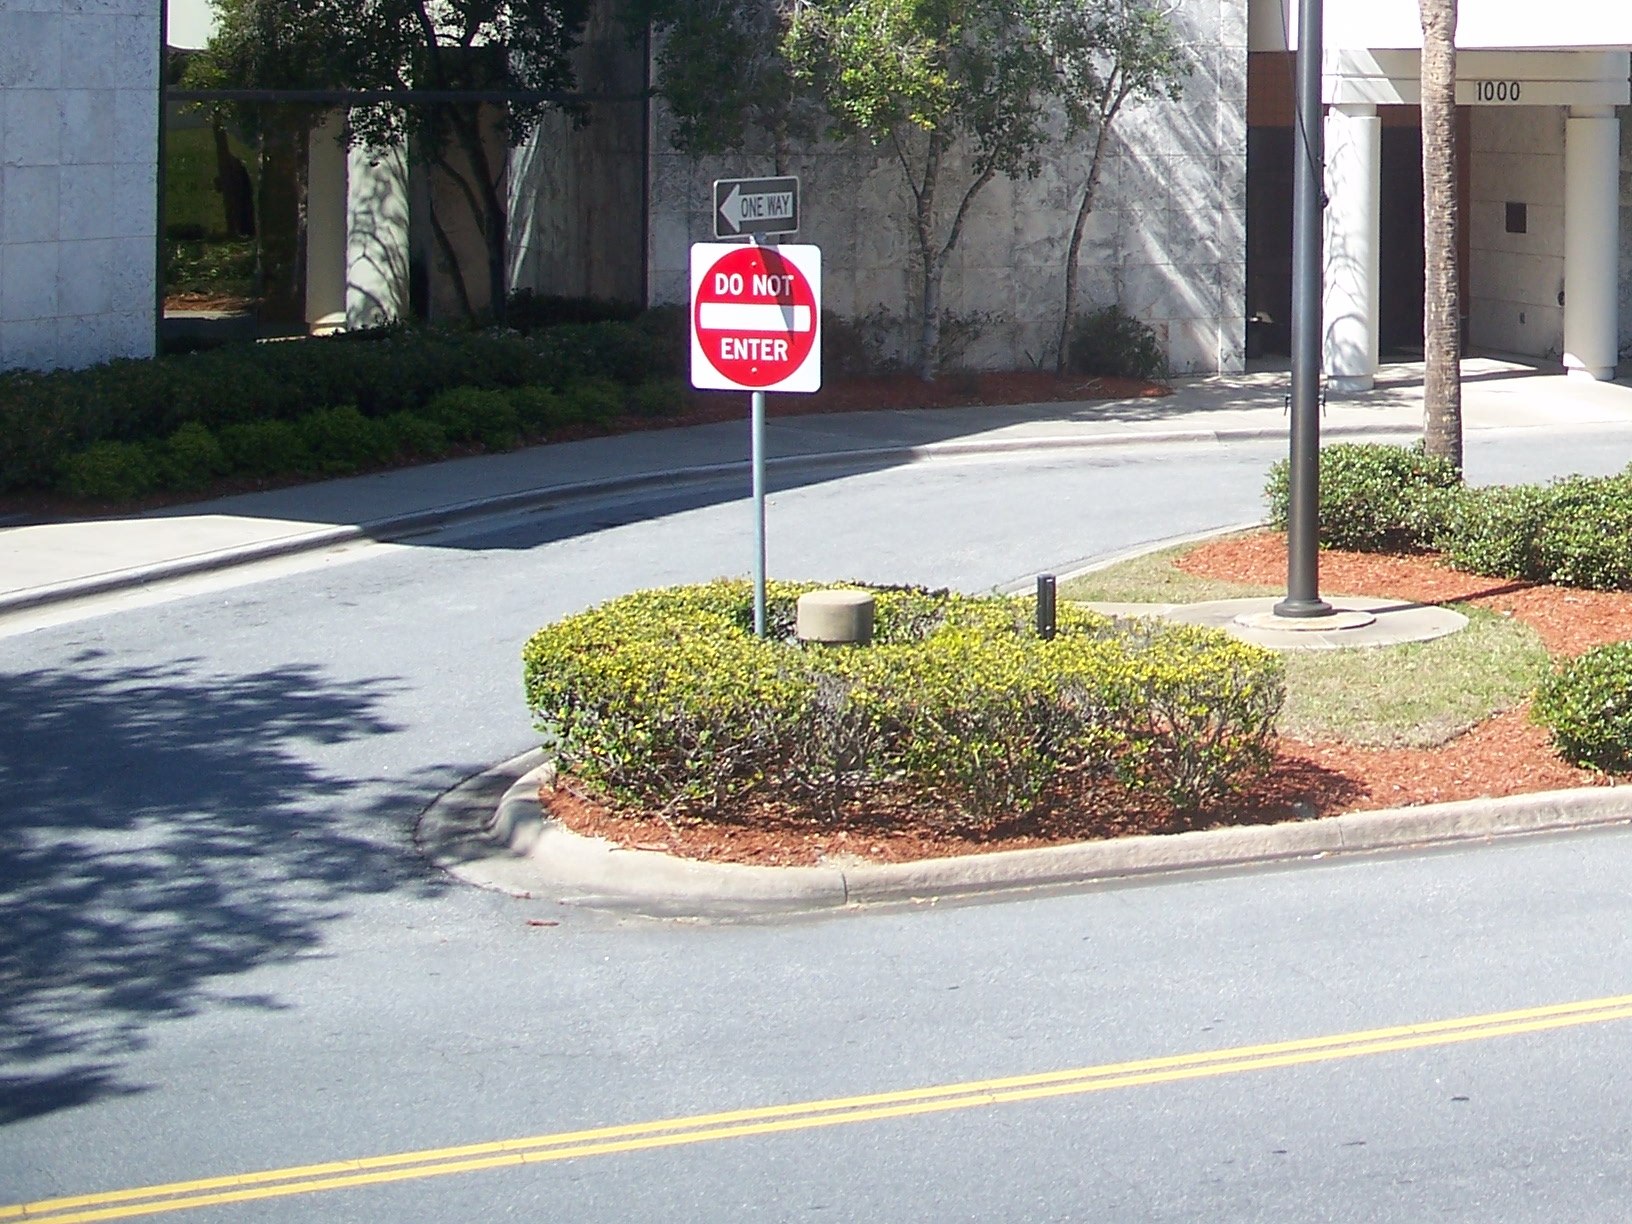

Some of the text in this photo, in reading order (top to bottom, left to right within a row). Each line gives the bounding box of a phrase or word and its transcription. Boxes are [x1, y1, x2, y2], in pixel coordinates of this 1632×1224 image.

[1477, 81, 1520, 101] 1000
[741, 194, 791, 218] ONE WAY
[715, 273, 794, 297] DO NOT
[721, 338, 788, 361] ENTER
